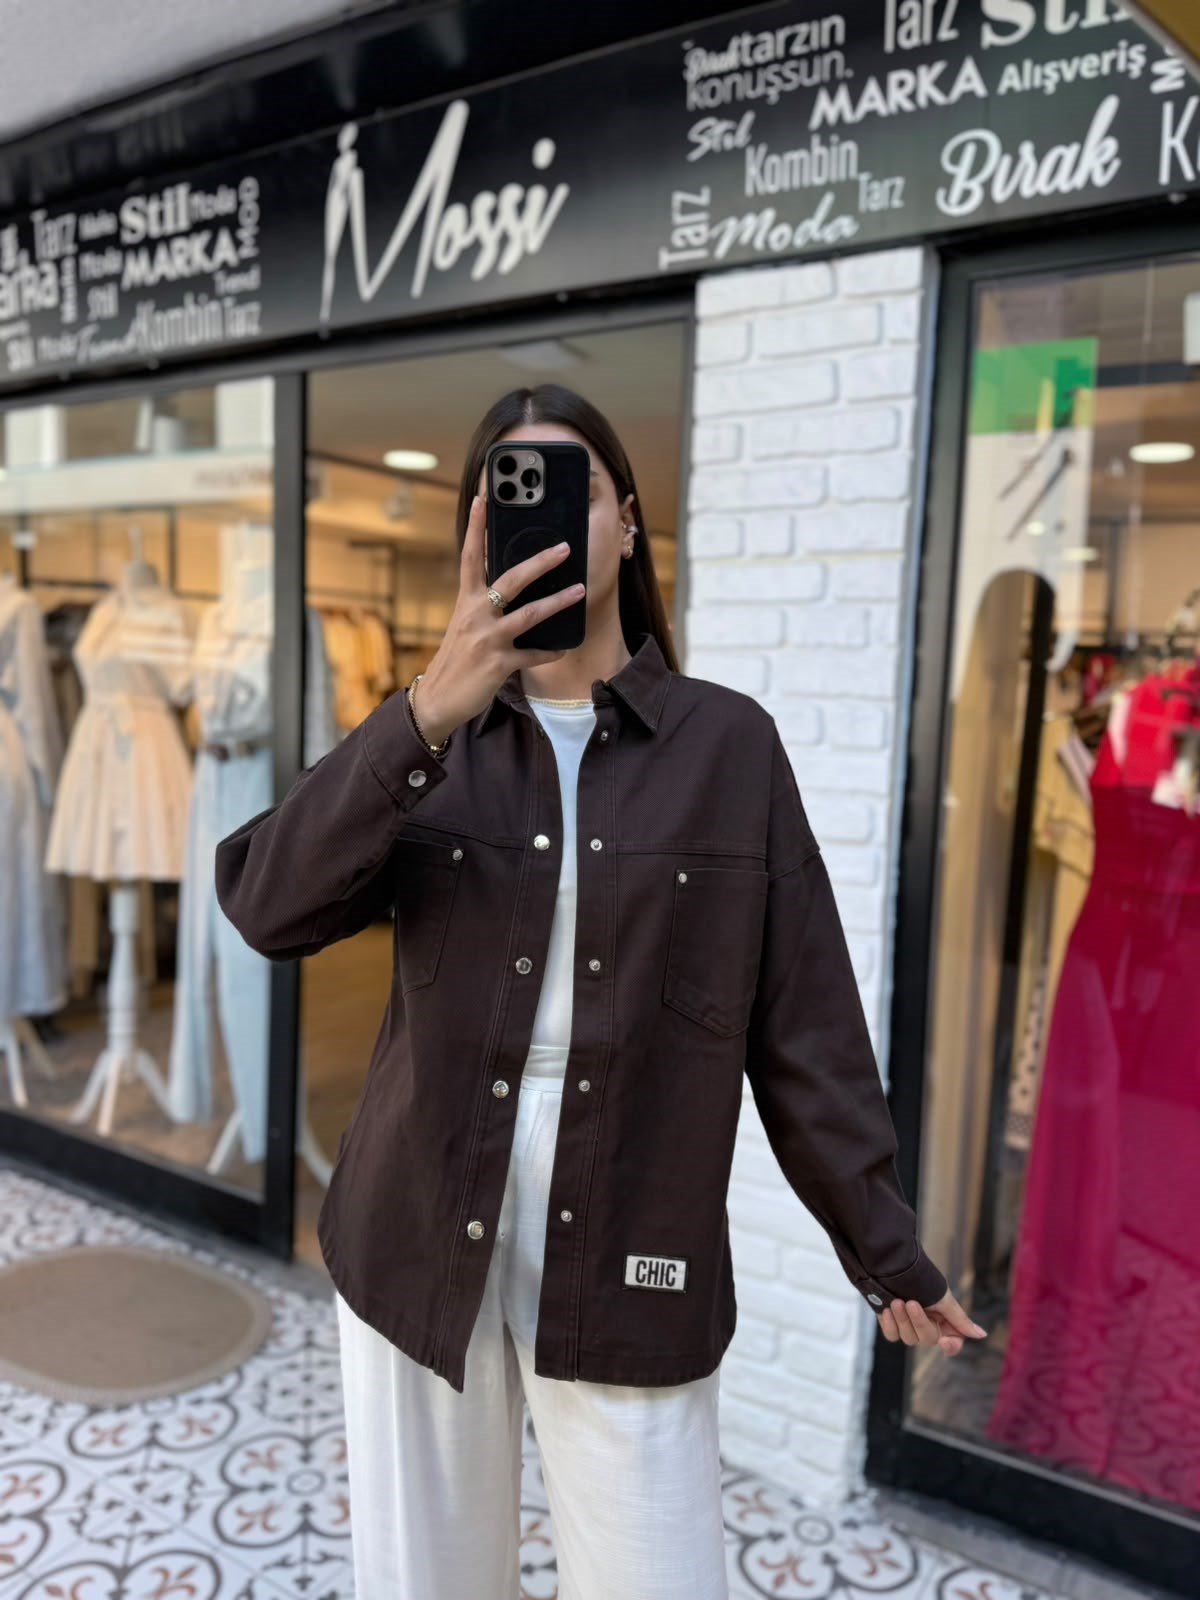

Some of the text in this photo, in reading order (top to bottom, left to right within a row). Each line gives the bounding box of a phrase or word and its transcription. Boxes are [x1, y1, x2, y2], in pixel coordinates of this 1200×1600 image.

[738, 14, 846, 67] tarzın
[997, 40, 1147, 95] Alışveriş
[808, 56, 988, 131] MARKA
[744, 134, 858, 196] Kombin
[936, 94, 1121, 216] Bırak
[119, 182, 191, 244] Stil
[319, 99, 570, 324] Mossi
[857, 171, 905, 213] Tarz
[658, 186, 711, 271] Tarz
[711, 192, 859, 260] Moda
[120, 226, 239, 293] MARKA
[635, 1259, 677, 1288] CHIC
